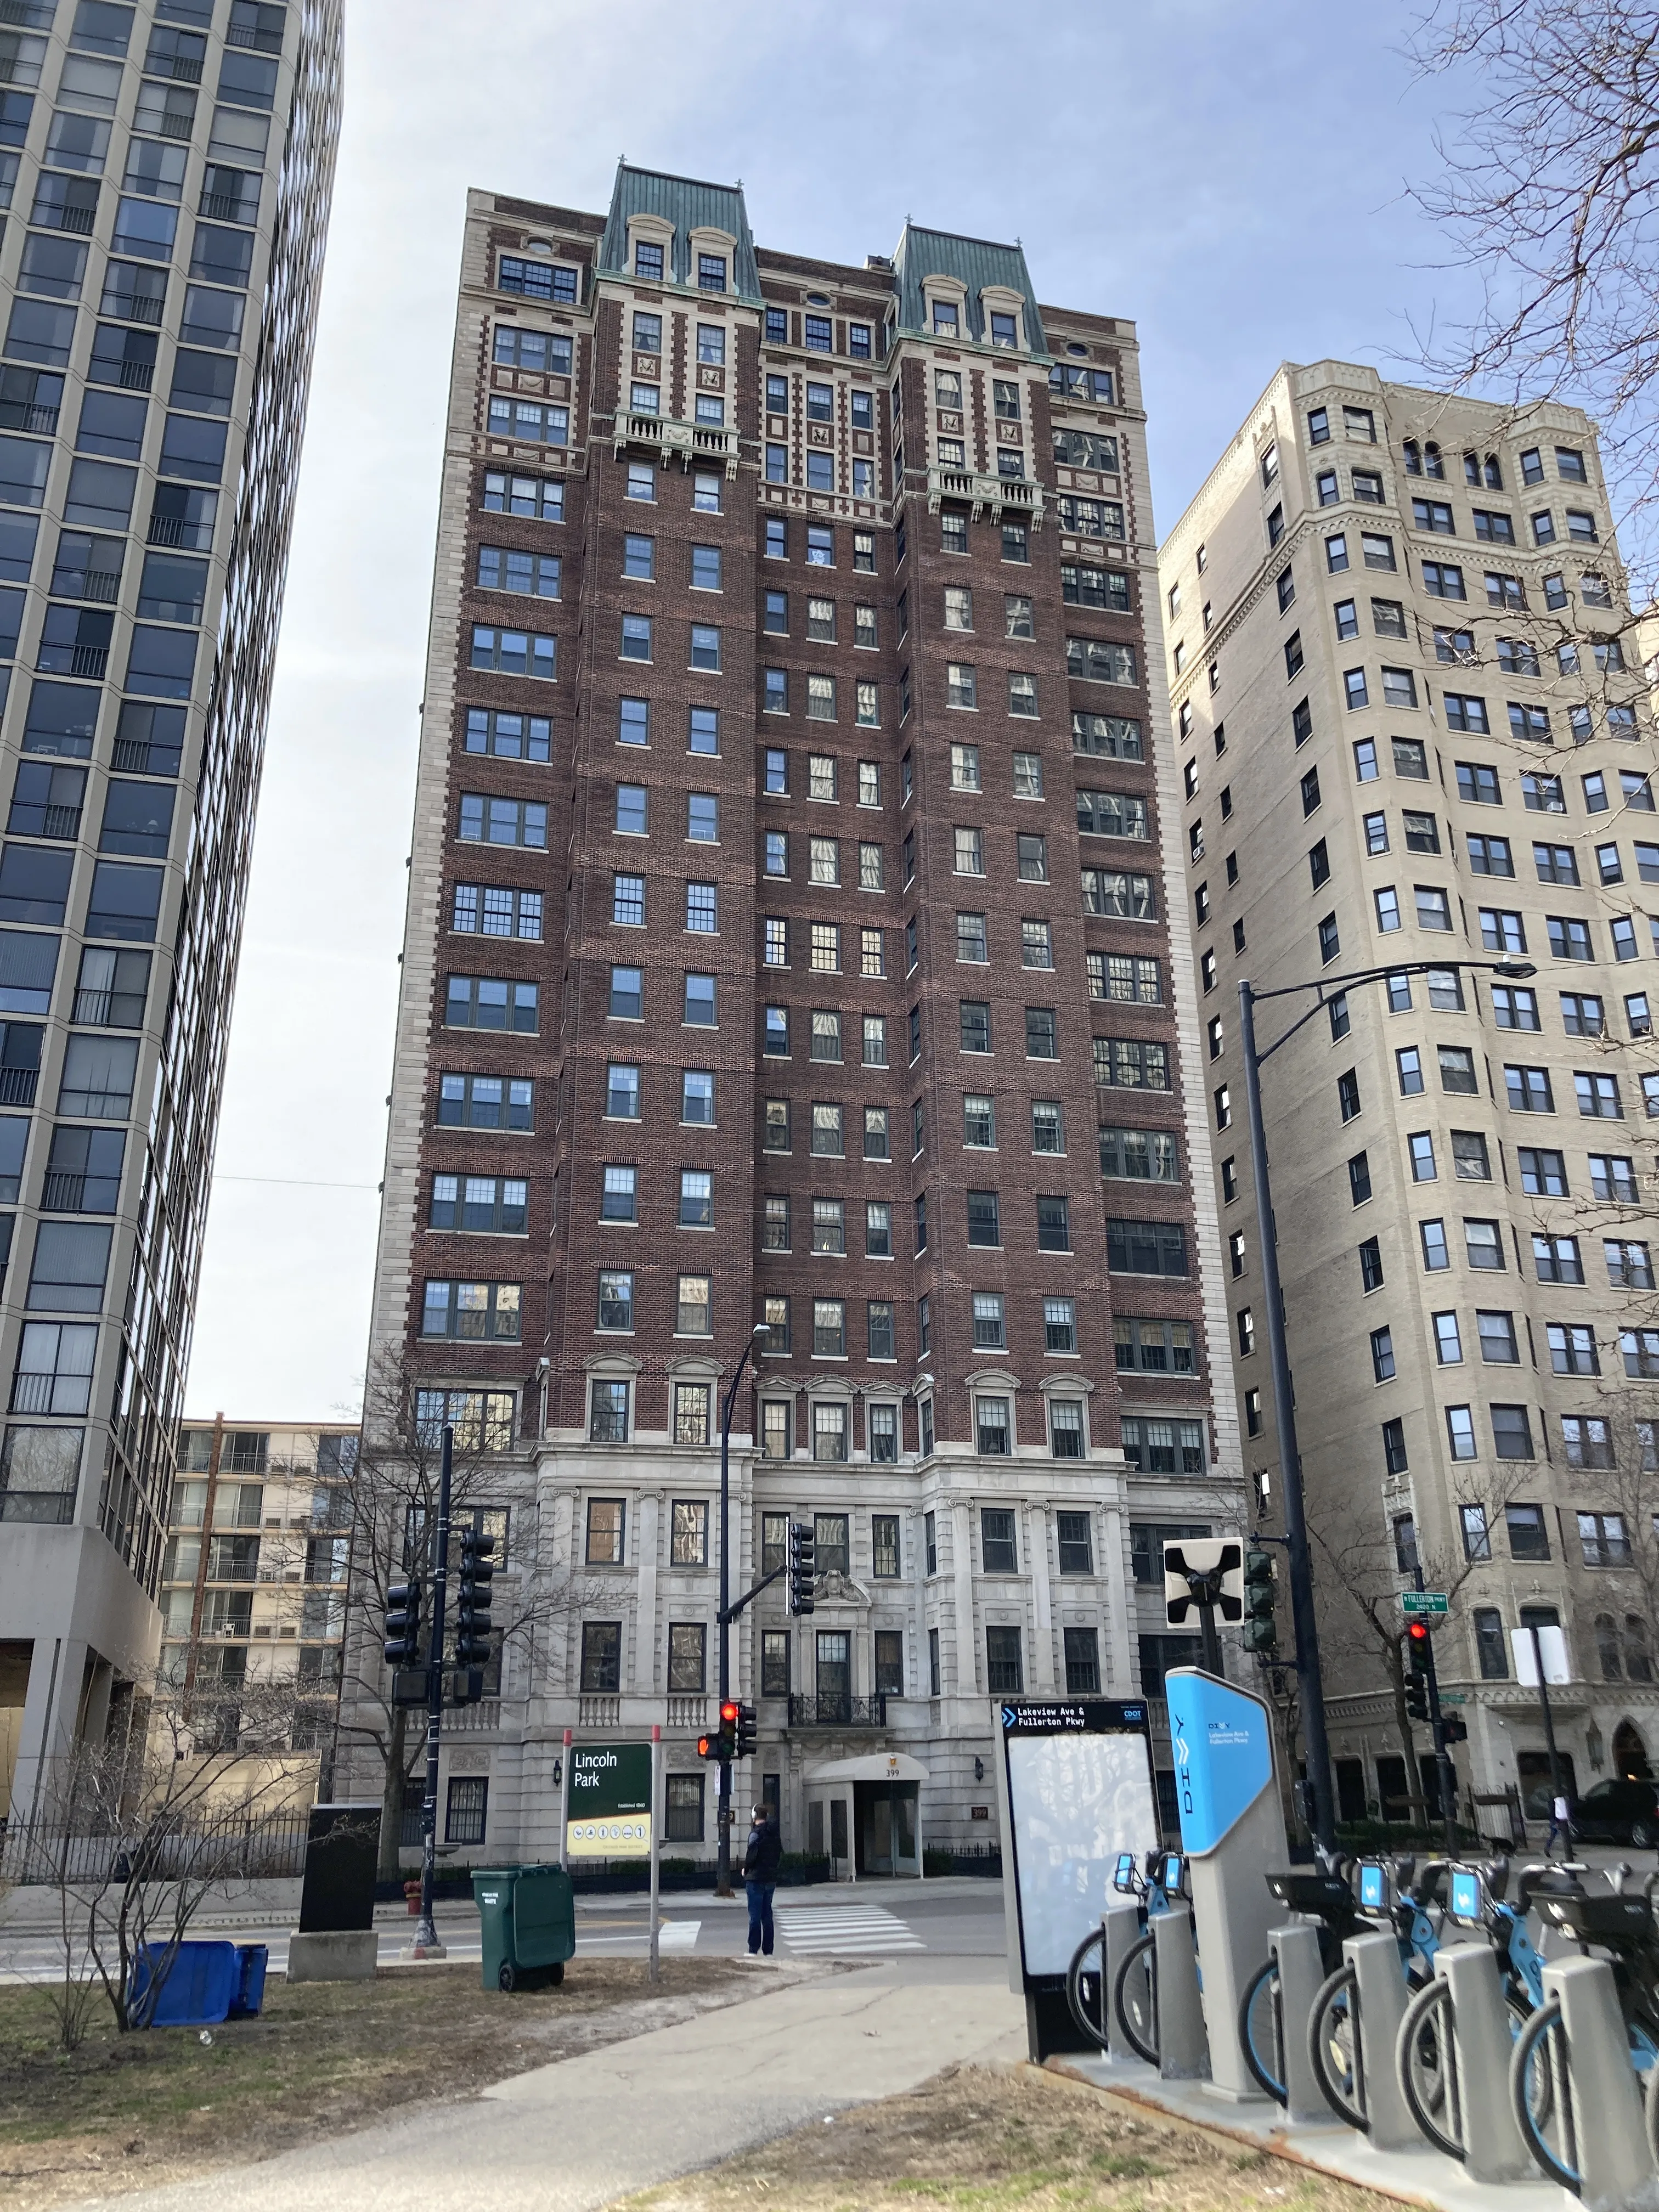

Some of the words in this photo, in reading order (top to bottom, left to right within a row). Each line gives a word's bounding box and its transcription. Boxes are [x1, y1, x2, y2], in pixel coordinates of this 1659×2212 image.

[1018, 1707, 1056, 1716] Lakeview
[1060, 1707, 1074, 1716] Ave
[1079, 1707, 1085, 1716] &
[1018, 1718, 1062, 1726] Fullerton
[1065, 1717, 1085, 1727] Pkwy
[575, 1751, 617, 1768] Lincoln
[886, 1769, 899, 1778] 399
[574, 1771, 600, 1787] Park
[973, 1809, 986, 1817] 399
